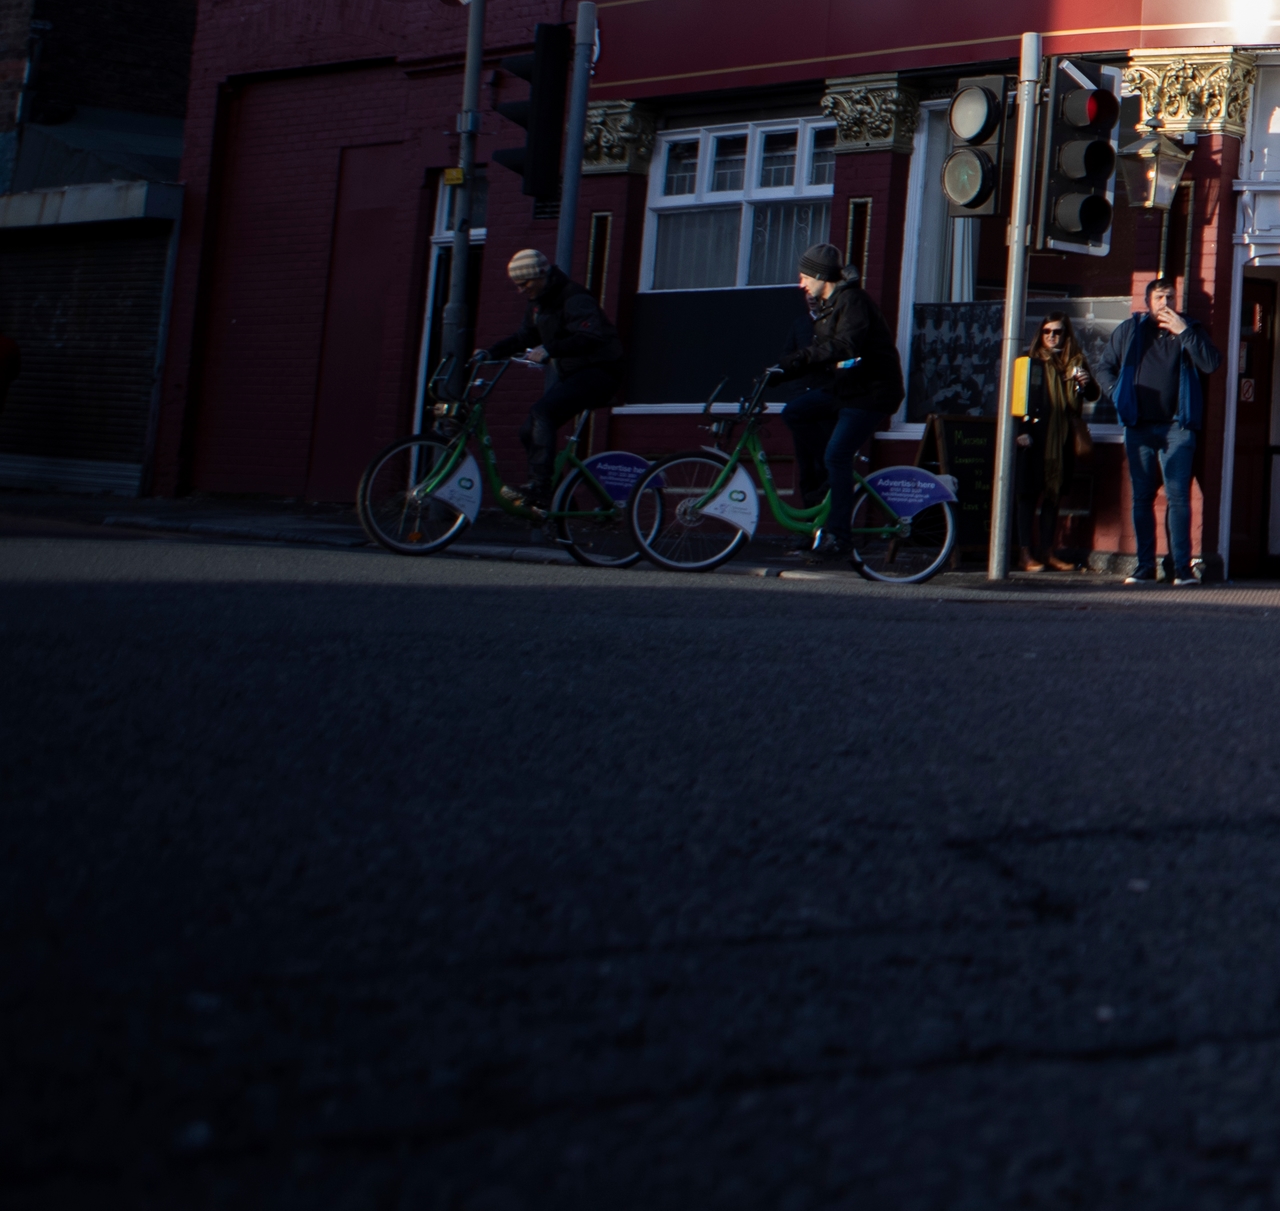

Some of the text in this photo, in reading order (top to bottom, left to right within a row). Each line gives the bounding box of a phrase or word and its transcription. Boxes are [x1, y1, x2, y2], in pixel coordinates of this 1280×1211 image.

[596, 462, 632, 472] Advertise
[877, 478, 936, 489] Advertise here
